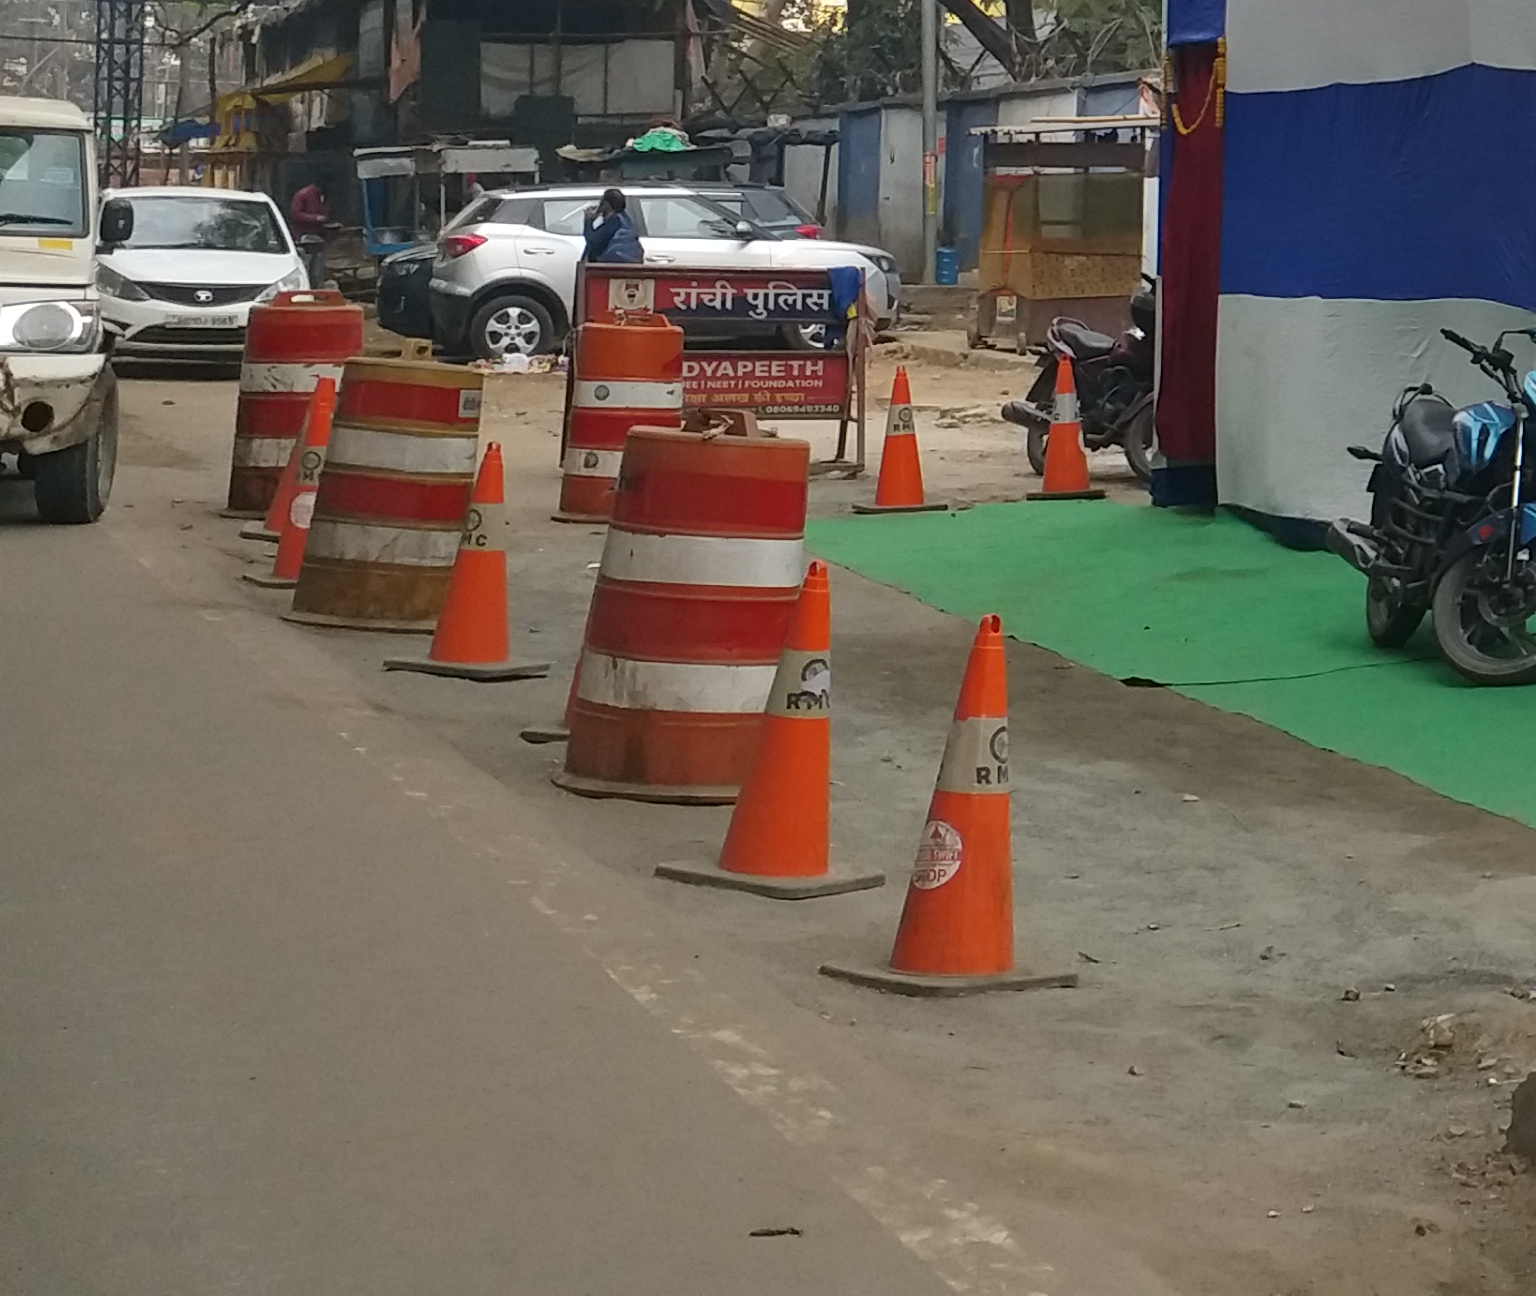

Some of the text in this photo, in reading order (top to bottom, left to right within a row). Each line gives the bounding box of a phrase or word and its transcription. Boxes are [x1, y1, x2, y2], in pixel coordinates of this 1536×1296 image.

[670, 280, 831, 320] रांची पुलिस
[682, 360, 824, 377] DYAPEETH
[706, 380, 736, 390] NEET
[744, 379, 824, 389] FOUNDATION
[975, 766, 1009, 785] RM
